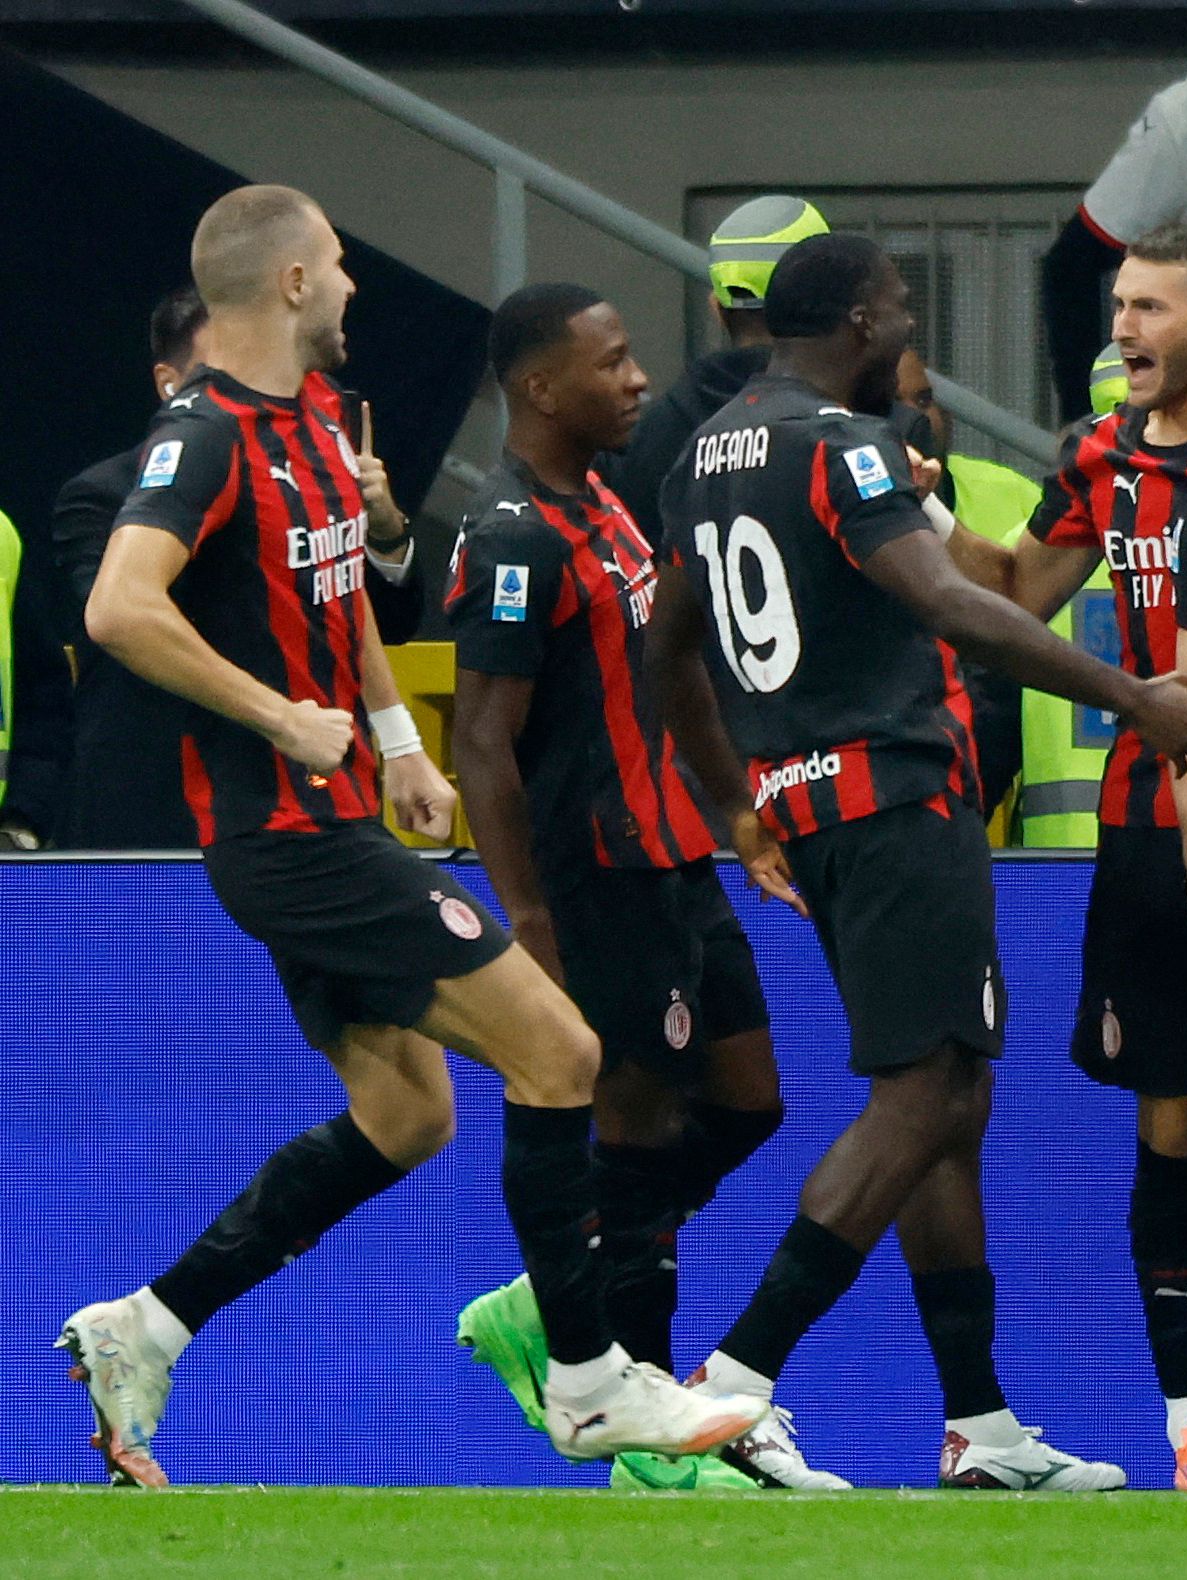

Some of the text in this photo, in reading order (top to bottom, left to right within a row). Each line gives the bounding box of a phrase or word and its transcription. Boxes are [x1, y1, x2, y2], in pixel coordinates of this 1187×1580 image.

[695, 425, 769, 480] FOFANA
[694, 515, 801, 693] 19
[1132, 573, 1163, 609] FLY
